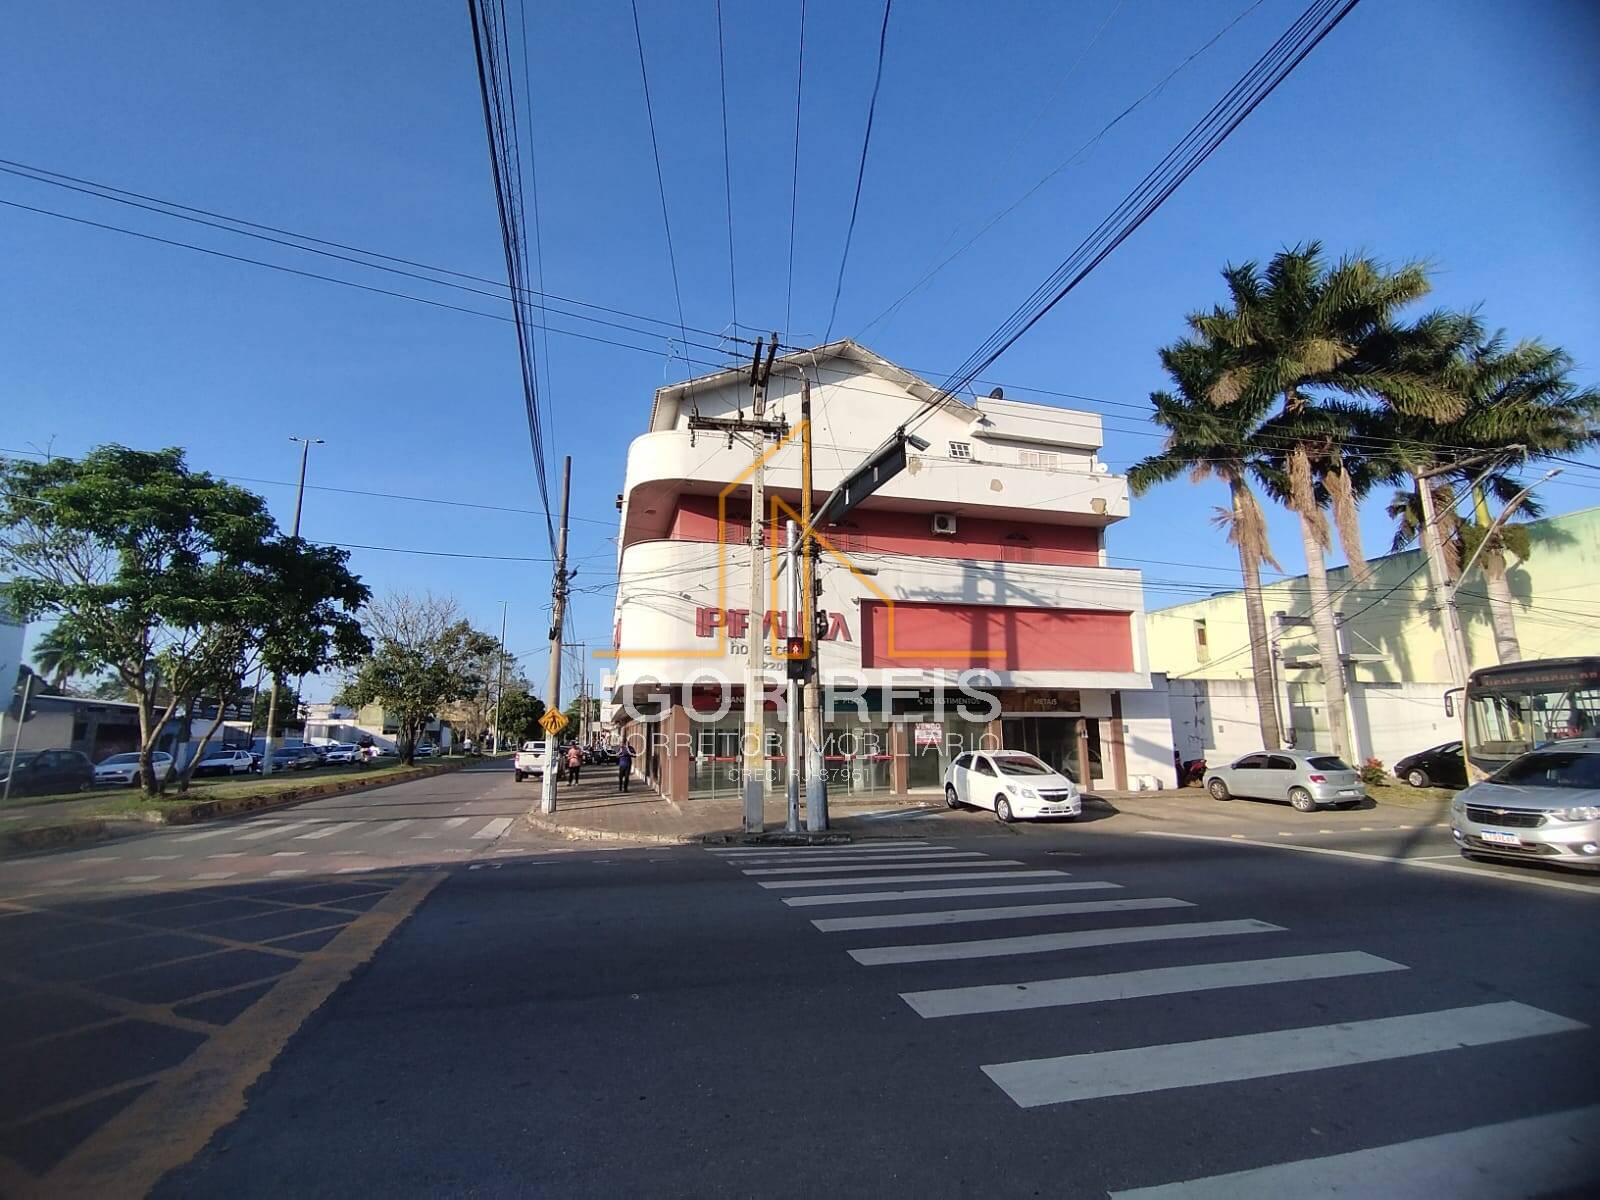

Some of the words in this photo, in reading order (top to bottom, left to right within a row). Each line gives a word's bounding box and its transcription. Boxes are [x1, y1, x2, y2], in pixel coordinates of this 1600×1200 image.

[730, 642, 772, 655] hoe
[924, 697, 981, 706] REVESTIMENTOS
[1033, 697, 1058, 706] METAIS
